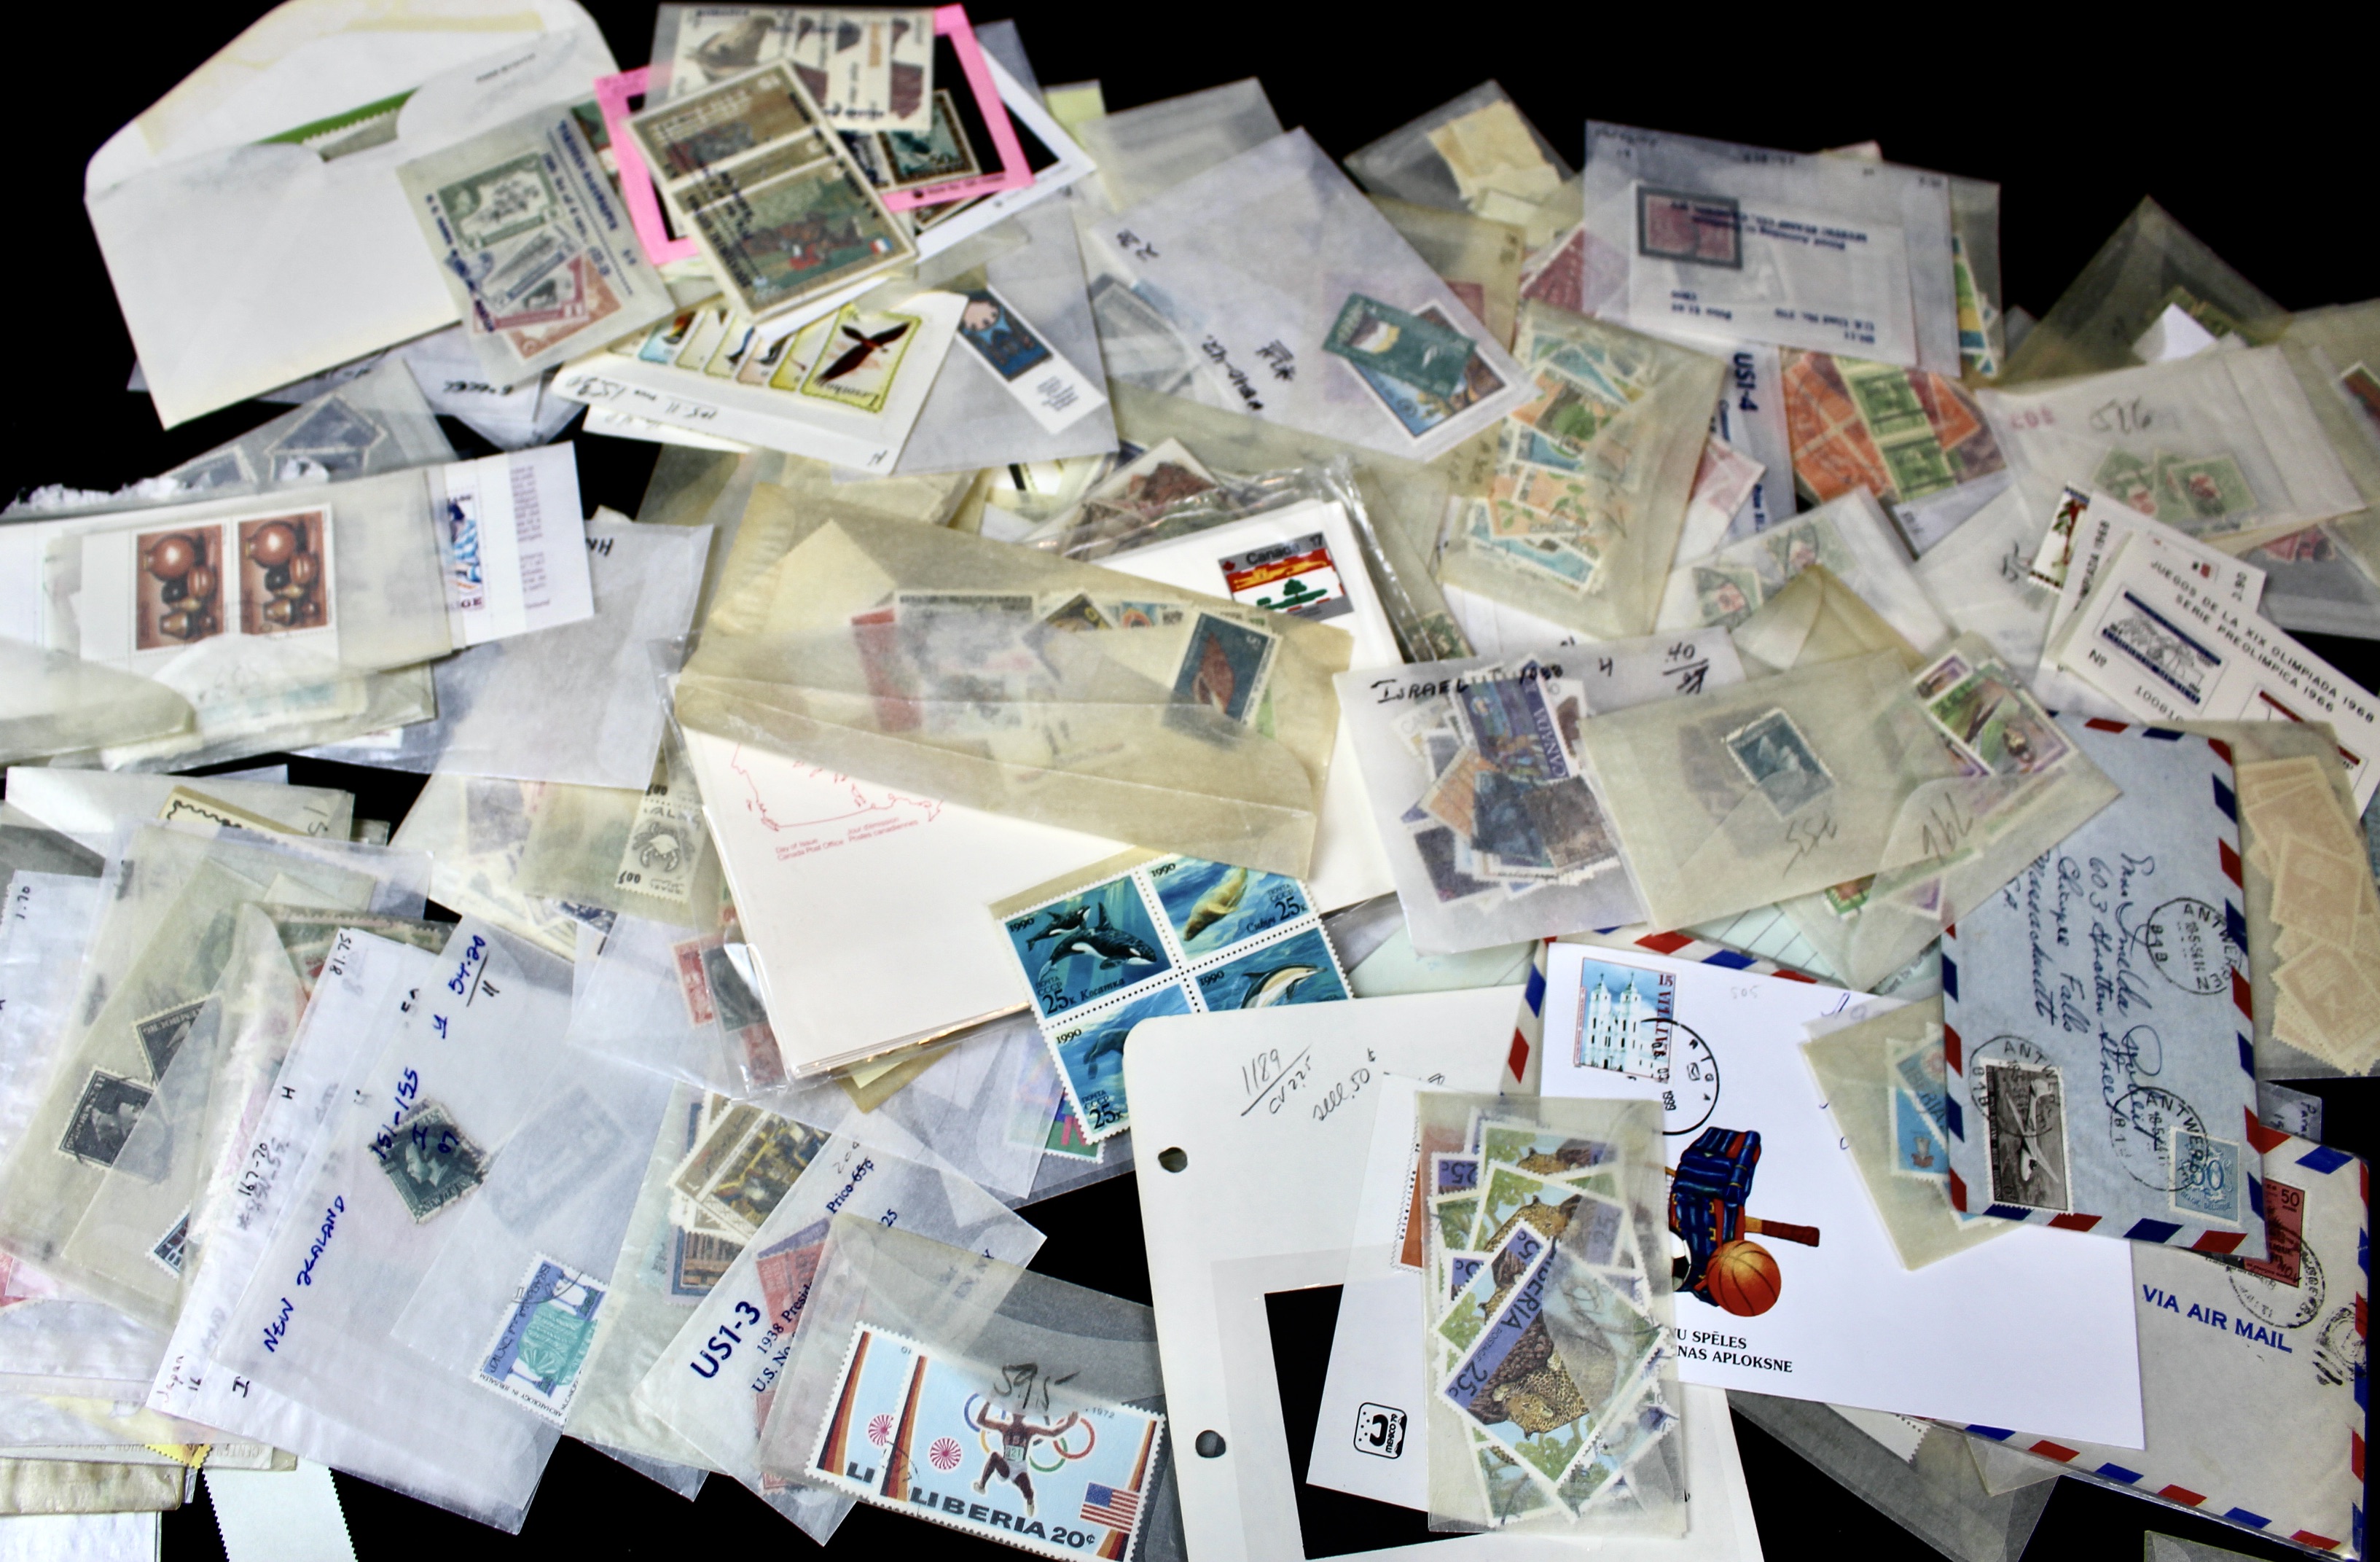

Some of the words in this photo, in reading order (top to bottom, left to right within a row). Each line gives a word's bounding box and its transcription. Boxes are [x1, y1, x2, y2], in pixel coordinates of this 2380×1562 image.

[1245, 540, 1302, 566] Canada
[1310, 533, 1324, 548] 17
[2150, 558, 2201, 598] JUEGOS
[2201, 595, 2221, 615] DE
[2221, 609, 2239, 629] LA
[2244, 625, 2269, 650] XIX
[2271, 642, 2339, 699] OLIMPIADA
[2342, 696, 2376, 725] 1968
[2175, 593, 2211, 625] SERIE
[2216, 622, 2300, 688] PREOLIMPICA
[2303, 684, 2336, 714] 1966
[1371, 677, 1471, 705] ISRAEL
[1151, 862, 1177, 879] 1990
[2088, 856, 2109, 911] 603
[1009, 917, 1036, 933] 1990
[1079, 976, 1126, 1001] Косатка
[1199, 970, 1226, 987] 1990
[1657, 973, 1674, 987] 15
[2059, 971, 2089, 1034] Falls
[1056, 1028, 1082, 1044] 1990
[1660, 1089, 1678, 1112] 1999
[238, 1141, 270, 1198] 167-70
[826, 1184, 854, 1215] Price
[2280, 1190, 2301, 1207] 50
[263, 1297, 295, 1354] NEW
[296, 1195, 347, 1286] ZEALAND
[2142, 1284, 2180, 1314] VIA
[2186, 1302, 2228, 1332] AIR
[2234, 1318, 2293, 1354] MAIL
[690, 1300, 762, 1380] US1-3
[755, 1322, 786, 1355] 1938
[1691, 1328, 1747, 1349] SPĒLES
[1711, 1350, 1793, 1374] APLOKSNE
[156, 1354, 185, 1403] Japan
[478, 1370, 510, 1395] JERUSALEM
[751, 1363, 780, 1394] U.S.
[1447, 1363, 1489, 1400] 25c
[520, 1393, 563, 1417] ARCHAEOLOGY
[1385, 1424, 1398, 1454] MEXICO
[911, 1485, 1049, 1541] LIBERIA
[1052, 1524, 1097, 1550] 20¢
